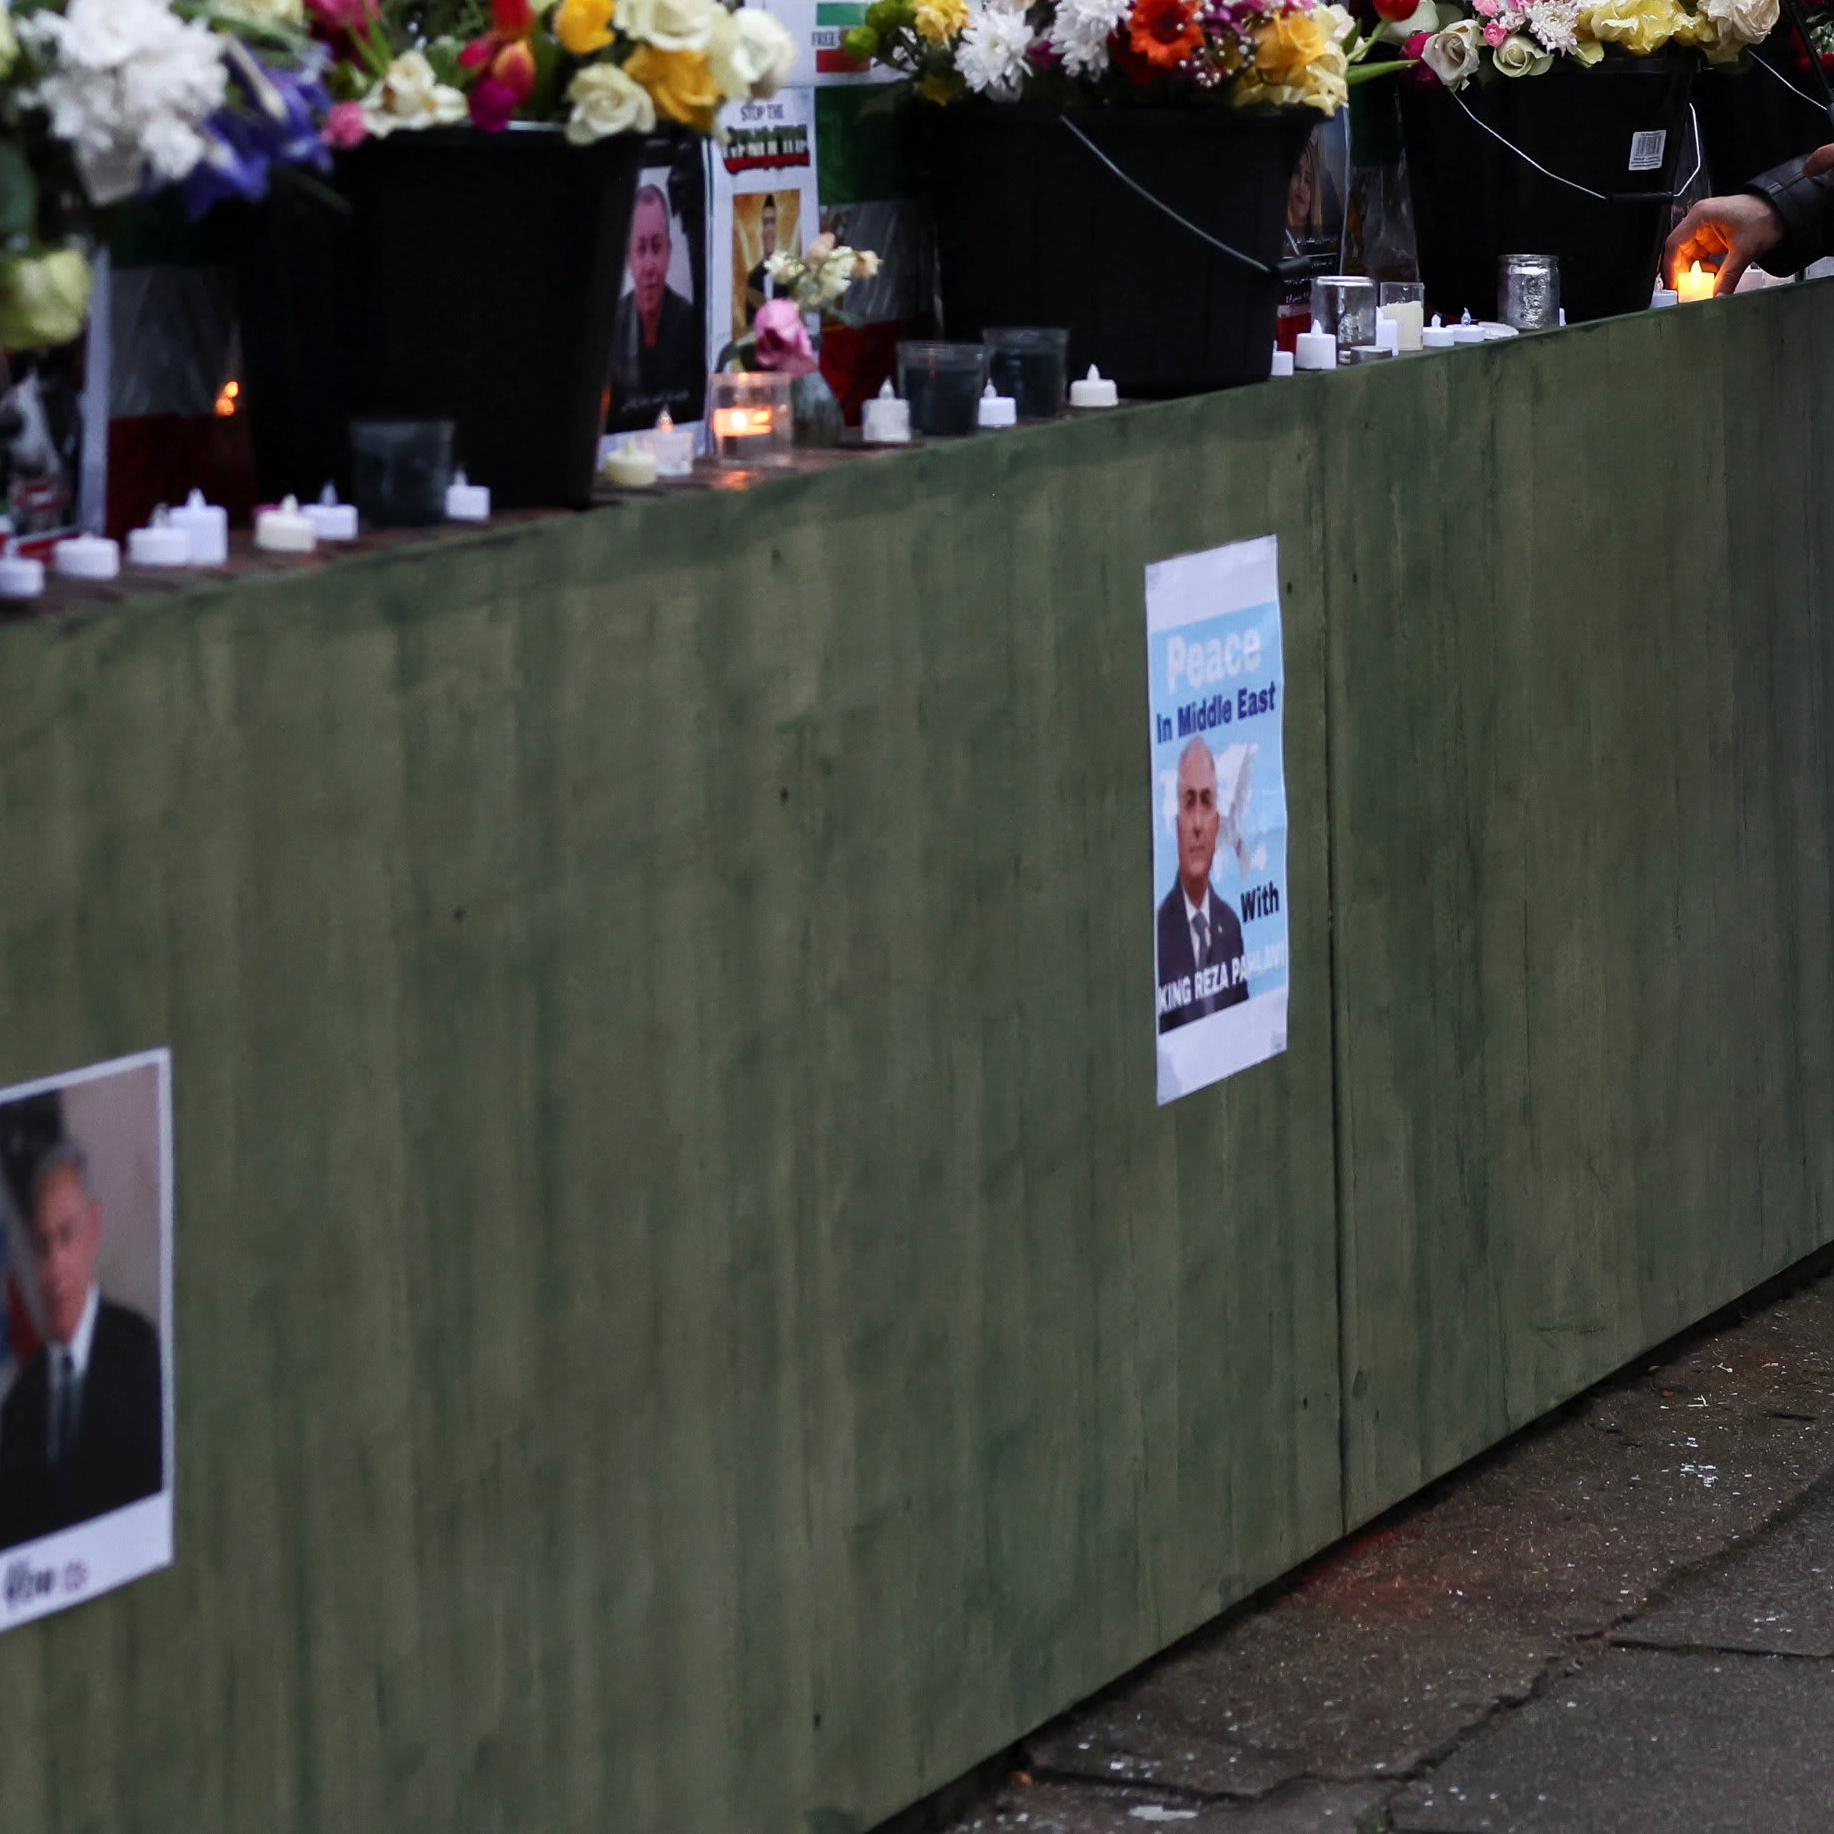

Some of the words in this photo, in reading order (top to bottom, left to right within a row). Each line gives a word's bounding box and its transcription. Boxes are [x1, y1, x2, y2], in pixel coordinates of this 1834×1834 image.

[1166, 624, 1261, 693] Peace
[1157, 711, 1173, 745] In
[1178, 691, 1232, 734] Middle
[1237, 681, 1278, 719] East
[1240, 883, 1281, 925] With
[1159, 969, 1192, 1015] KING
[1194, 960, 1231, 1002] REZA
